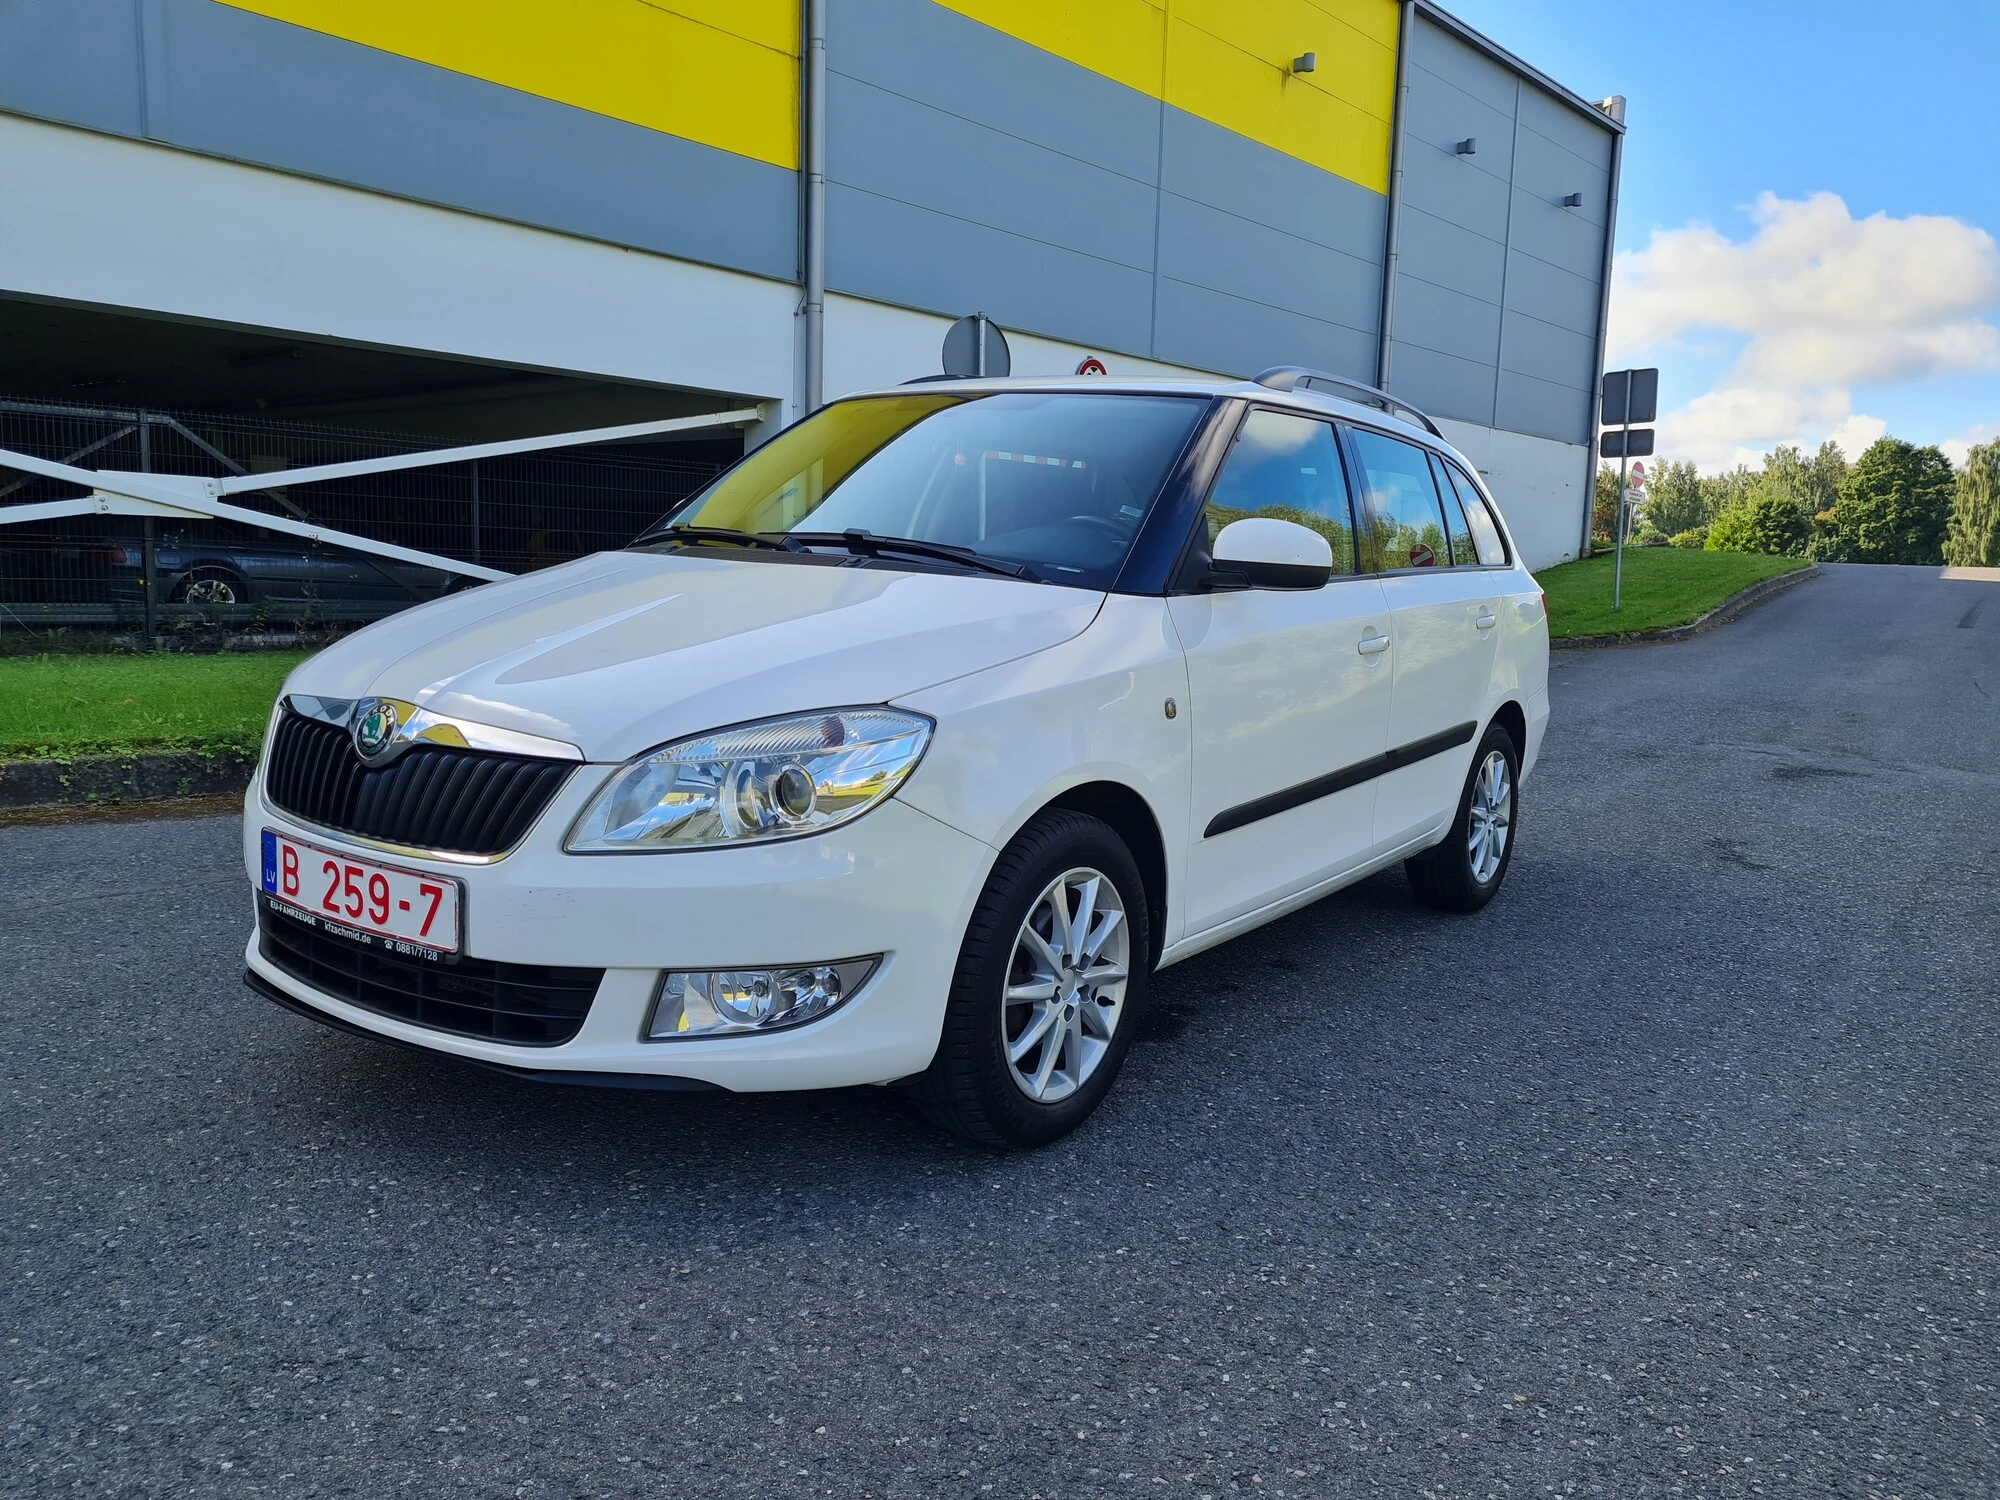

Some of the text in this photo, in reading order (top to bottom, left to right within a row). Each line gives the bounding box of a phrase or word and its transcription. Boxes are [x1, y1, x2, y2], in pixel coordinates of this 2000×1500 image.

[266, 869, 276, 884] LV
[282, 844, 443, 937] B 259-7
[270, 899, 316, 926] EU-FAHRZEUGE
[396, 941, 438, 962] 0881/7128
